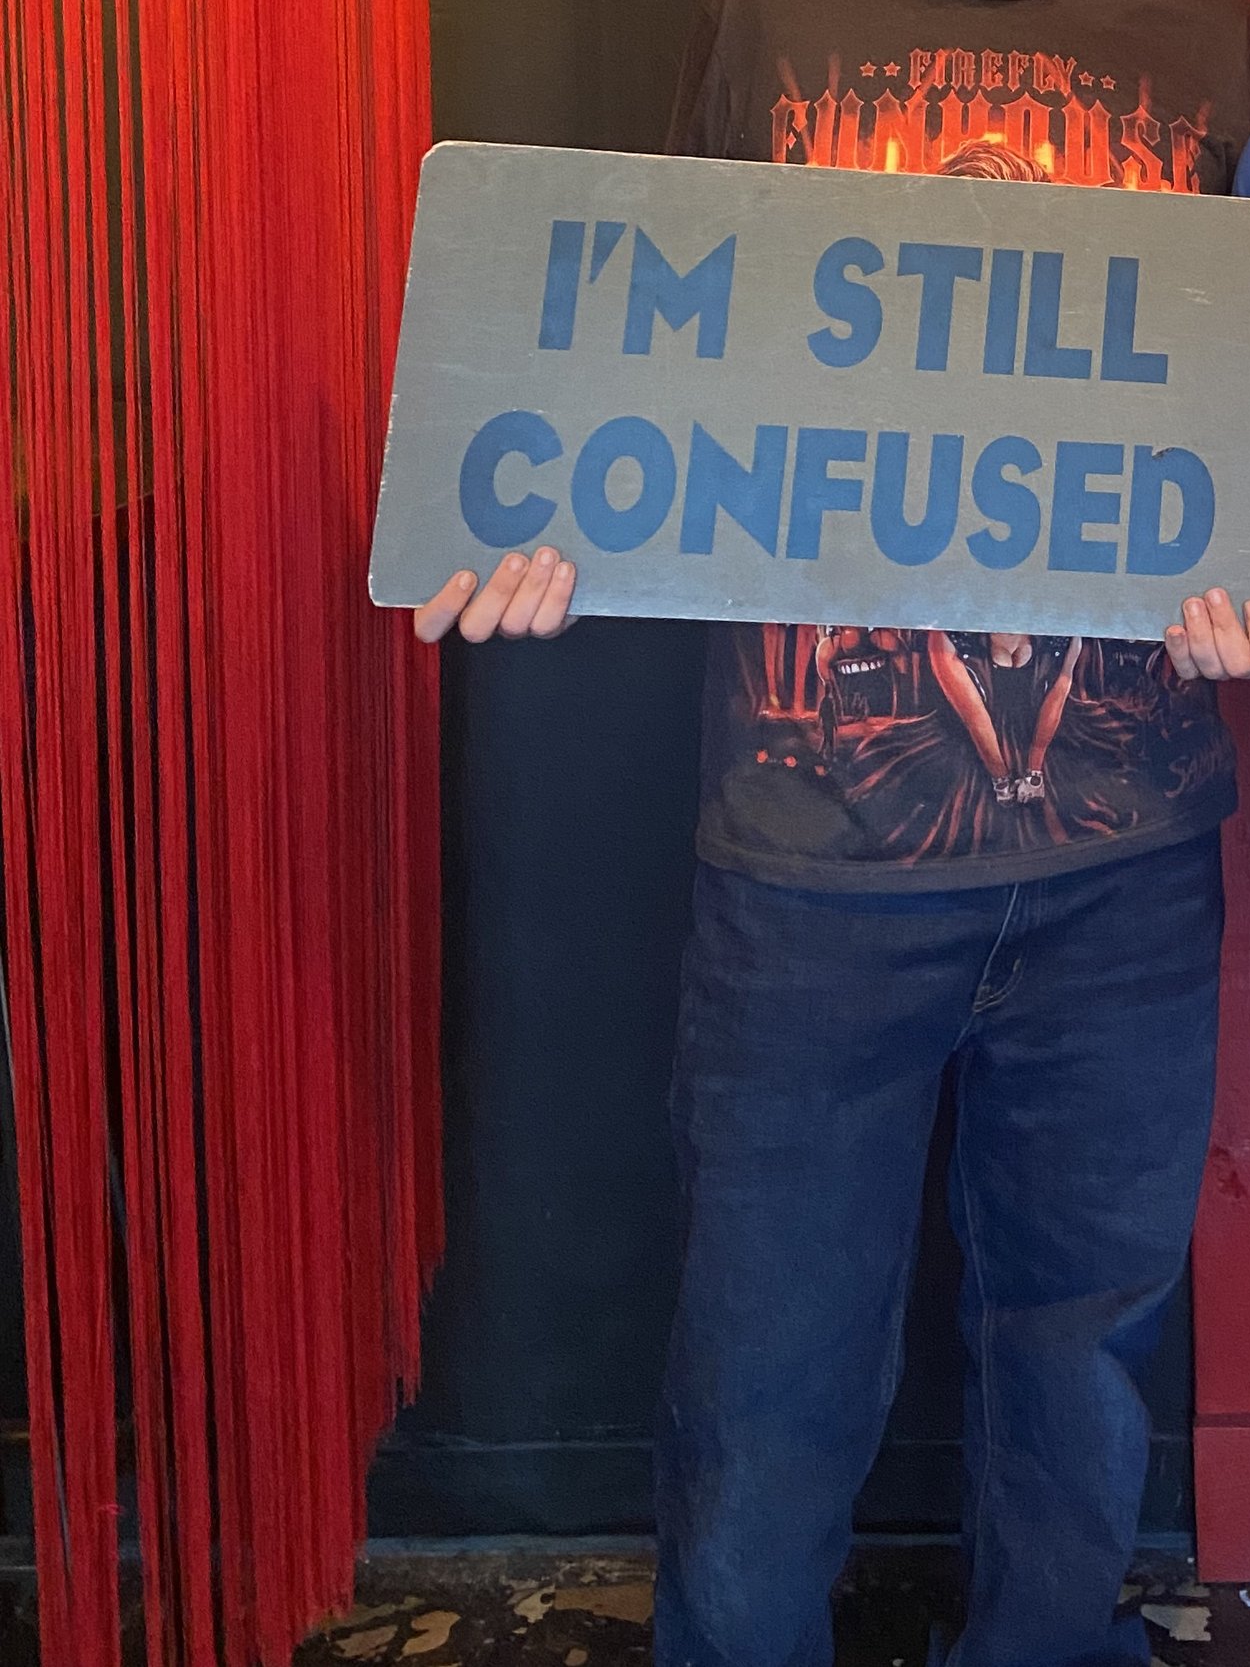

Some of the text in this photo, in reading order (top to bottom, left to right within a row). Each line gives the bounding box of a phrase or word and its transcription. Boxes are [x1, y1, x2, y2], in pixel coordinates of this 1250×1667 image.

[908, 48, 1077, 97] FIREFLY
[770, 89, 1207, 193] FUNHOUSE
[538, 221, 1169, 384] I'M STILL
[459, 410, 1216, 576] CONFUSED
